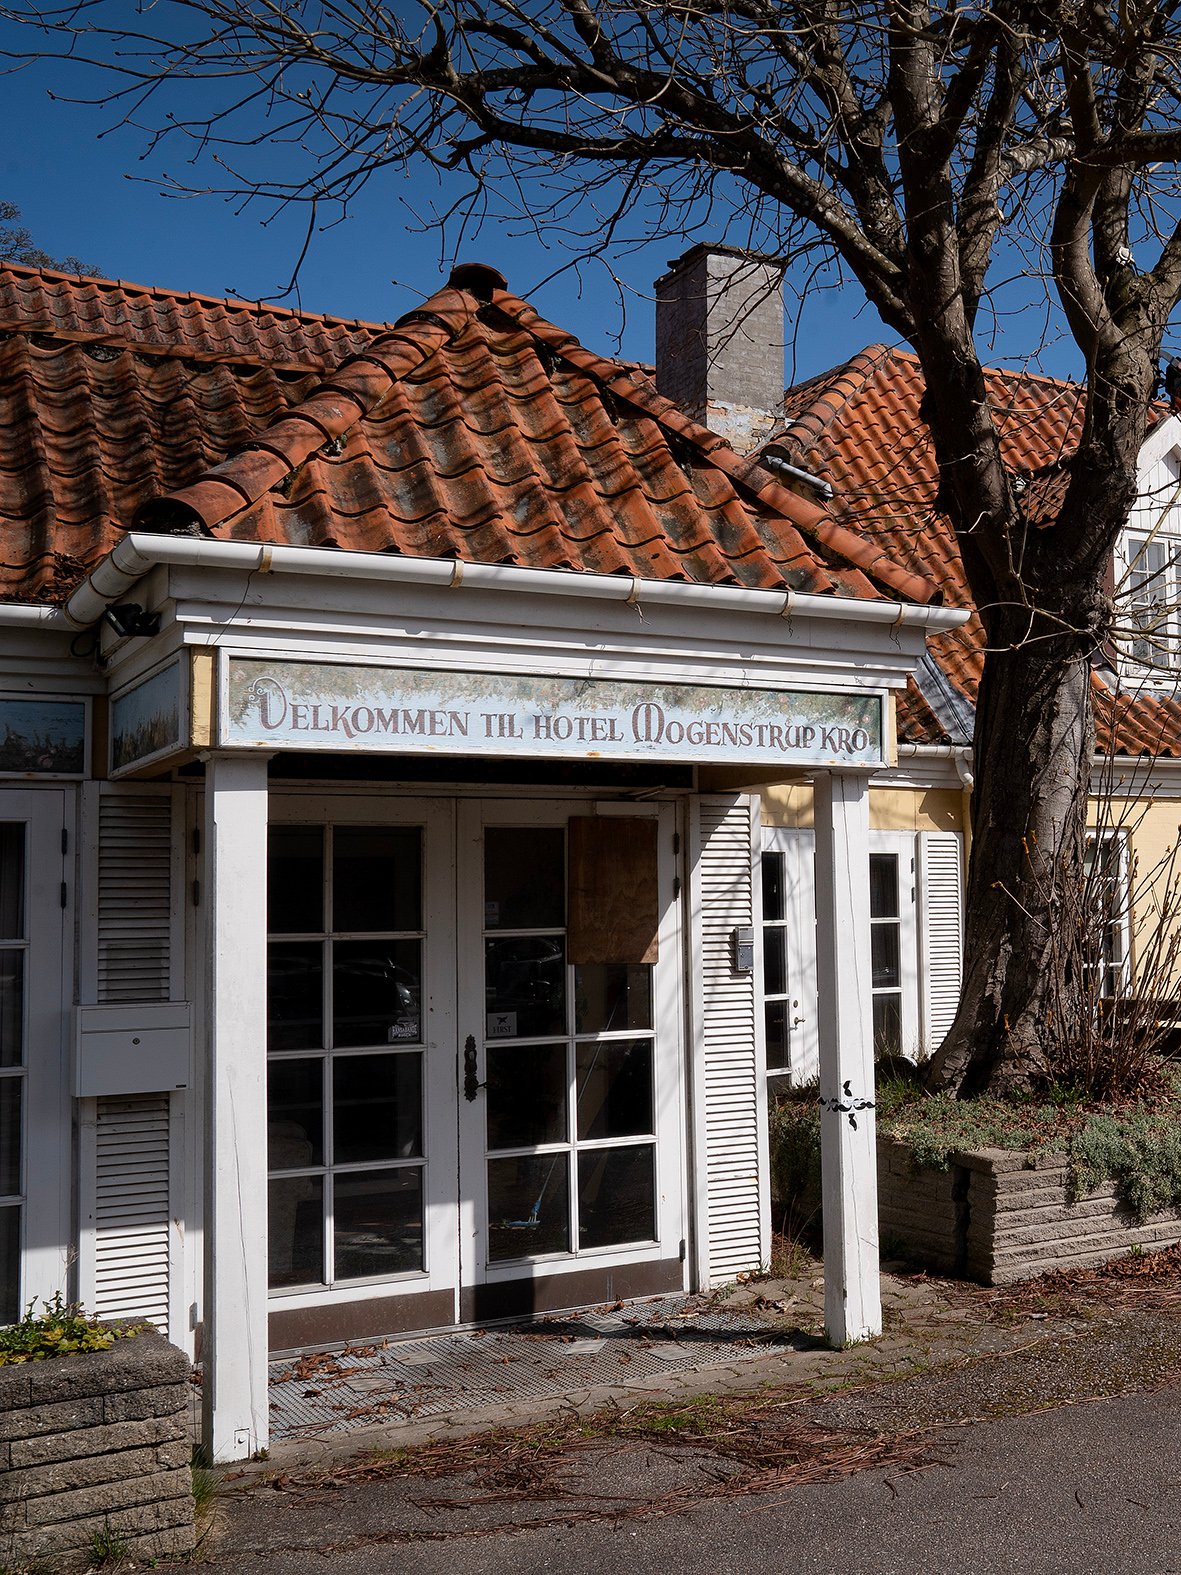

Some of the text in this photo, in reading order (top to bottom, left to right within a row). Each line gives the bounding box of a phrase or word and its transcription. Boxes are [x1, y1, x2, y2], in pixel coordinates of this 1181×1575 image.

[248, 676, 869, 755] VELKOMMEN TIL HOTEL MOGENSTRUP KRO
